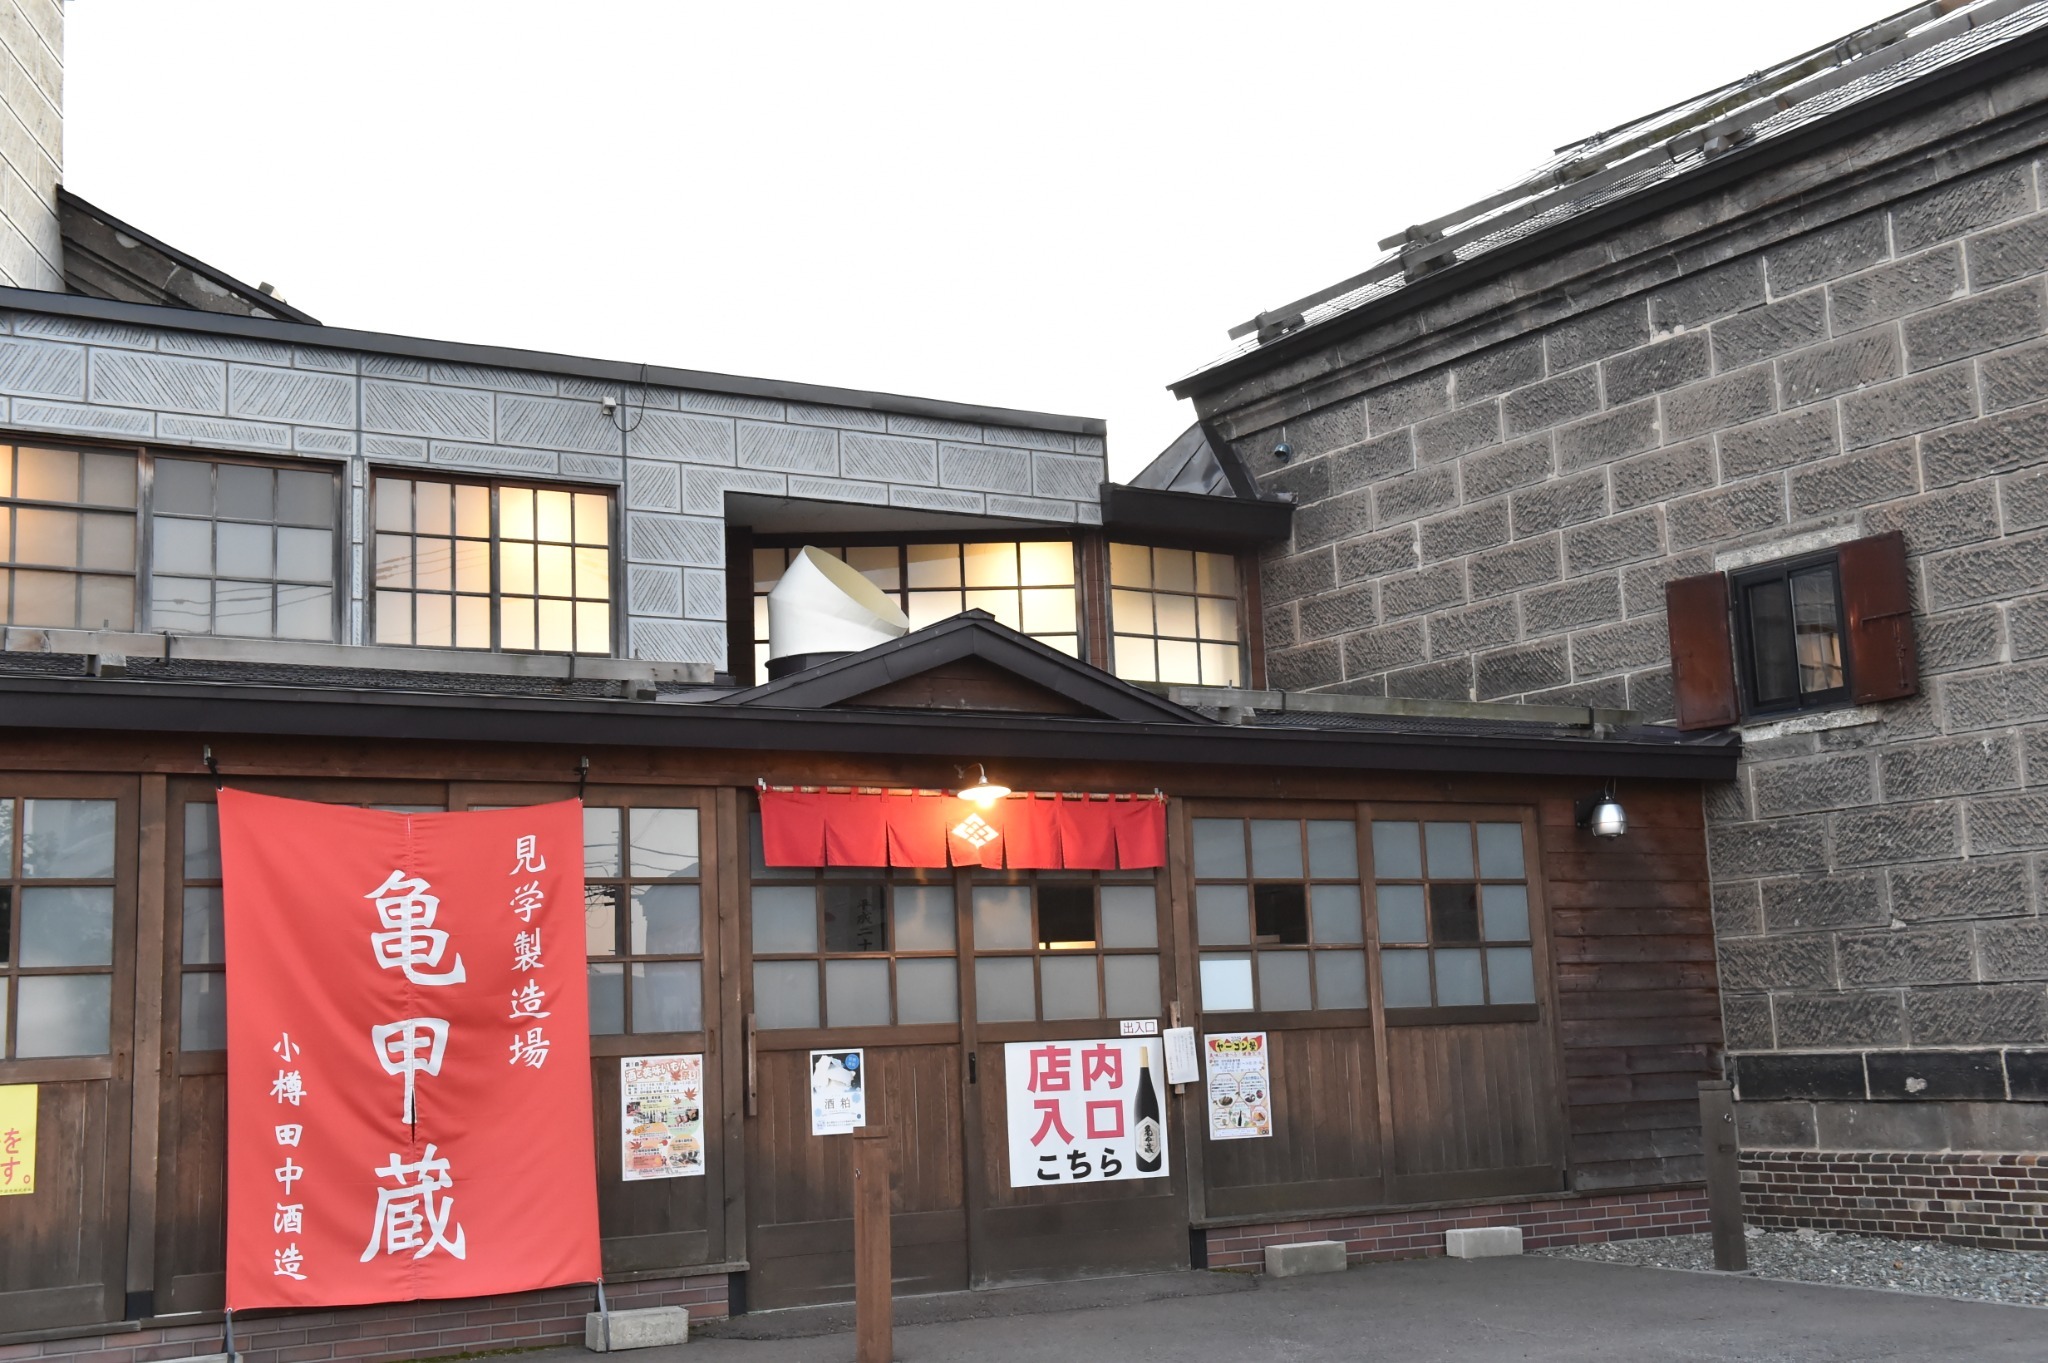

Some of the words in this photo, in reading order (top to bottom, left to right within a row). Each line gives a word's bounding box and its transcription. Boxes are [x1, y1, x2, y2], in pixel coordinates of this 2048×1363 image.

[508, 833, 551, 1070] 見学製造場
[1122, 1021, 1157, 1035] 出入口
[359, 869, 467, 1264] 亀甲蔵
[1027, 1043, 1124, 1093] 店内
[824, 1096, 851, 1110] 酒粕
[1030, 1098, 1125, 1147] 入口
[3, 1127, 22, 1154] を
[1036, 1148, 1123, 1181] こちら
